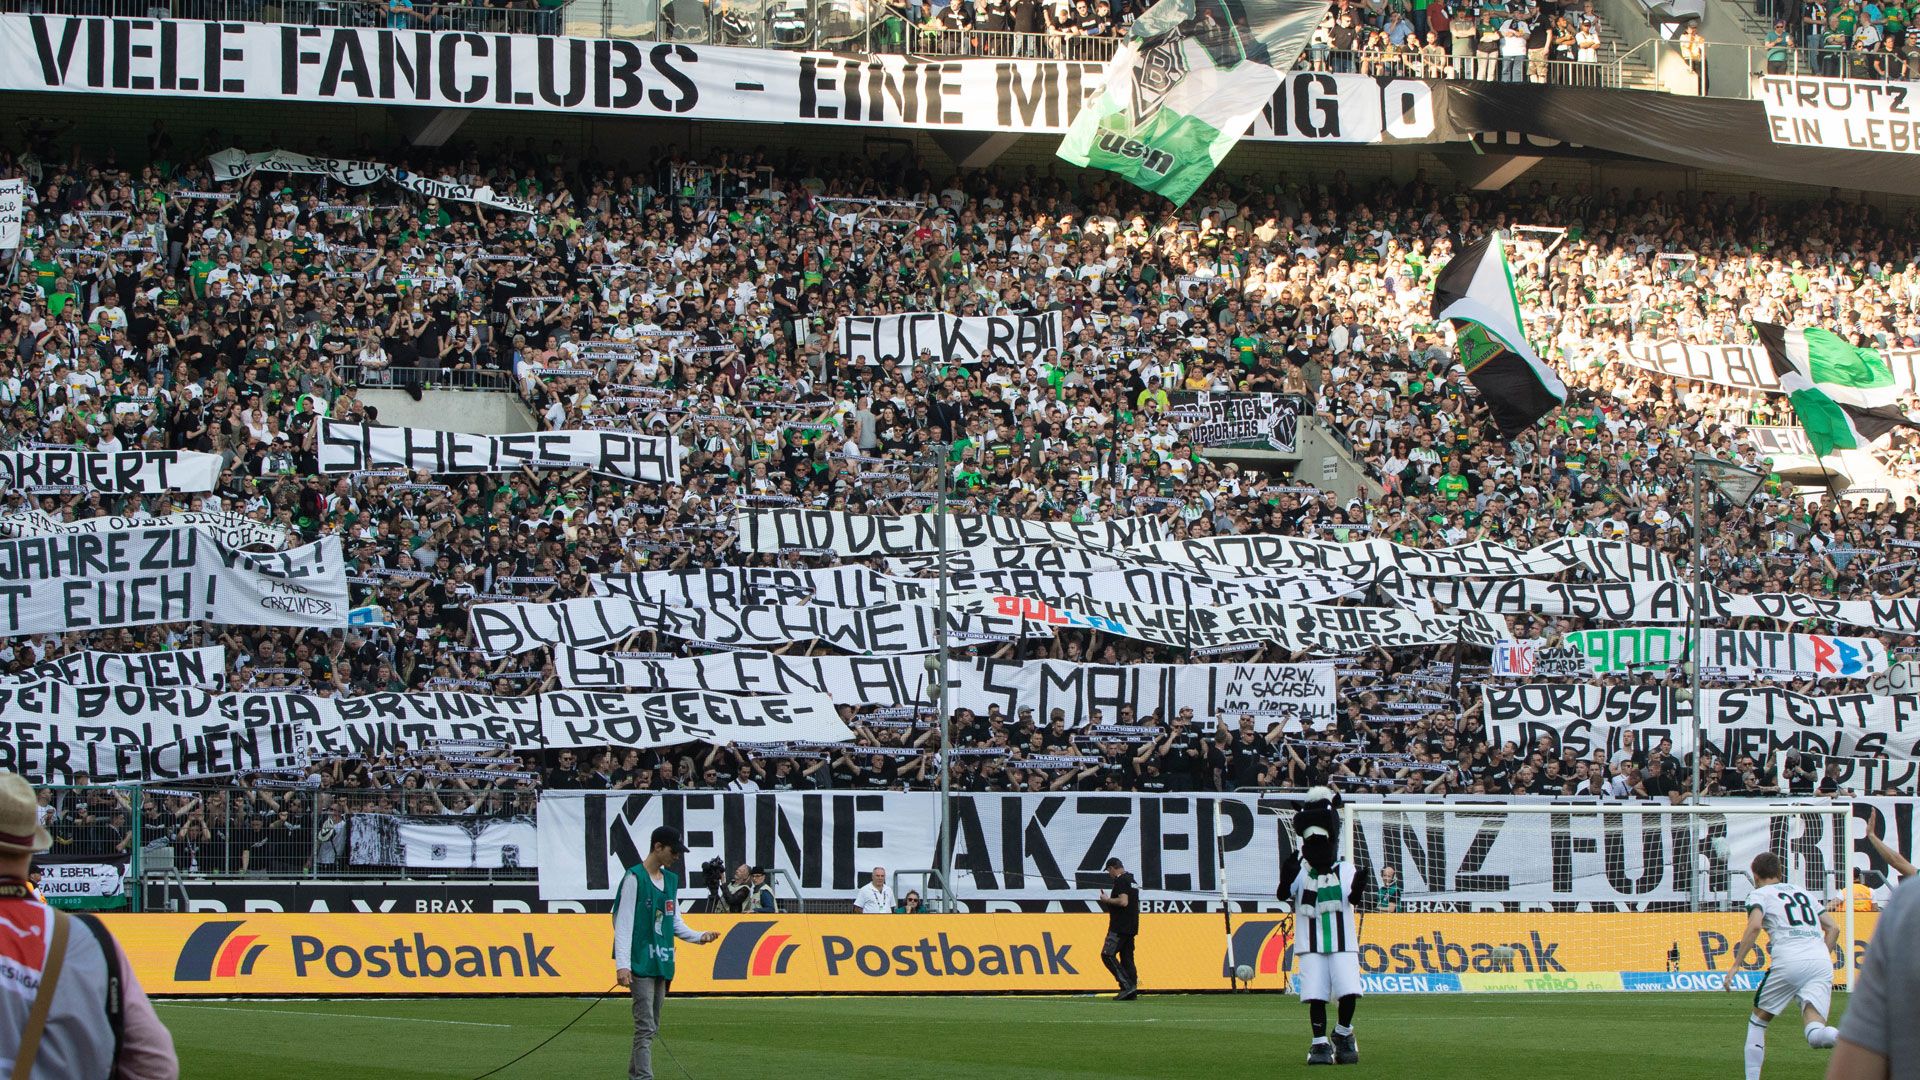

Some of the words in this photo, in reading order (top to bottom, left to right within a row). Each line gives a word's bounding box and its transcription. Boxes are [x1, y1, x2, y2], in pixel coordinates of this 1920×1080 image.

[27, 14, 246, 94] VIELE
[281, 26, 699, 113] FANCLUBS
[799, 57, 963, 126] EINE
[1770, 115, 1823, 144] EIN
[846, 314, 980, 365] FUCK
[1191, 420, 1258, 443] UPPORTERS
[0, 530, 130, 580] JAHRE
[140, 527, 197, 571] ZU
[844, 513, 939, 554] DEN
[946, 631, 1009, 640] RADITIONSVEREIN
[1715, 629, 1797, 671] ANTI
[1809, 633, 1875, 675] RB!
[1226, 682, 1242, 697] IN
[1250, 681, 1326, 698] SACHSEN
[1234, 666, 1255, 681] IN
[76, 682, 321, 728] BORUSSIA
[335, 692, 527, 720] BRENNT
[547, 692, 630, 718] DIE
[1486, 684, 1696, 726] BORUSSIA
[1718, 687, 1875, 729] STEHT
[87, 728, 260, 783] LEICHEN
[584, 794, 884, 891] KEINE
[928, 796, 1510, 893] AKZEPTNZ
[1769, 802, 1915, 892] RB!
[60, 867, 98, 878] EBERL
[416, 900, 474, 914] BRAX
[1139, 900, 1192, 914] BRAX
[1778, 891, 1817, 927] 28
[291, 932, 561, 978] Postbank
[821, 931, 1079, 977] Postbank
[1358, 930, 1567, 975] ostbank
[1667, 974, 1751, 991] JONGEN
